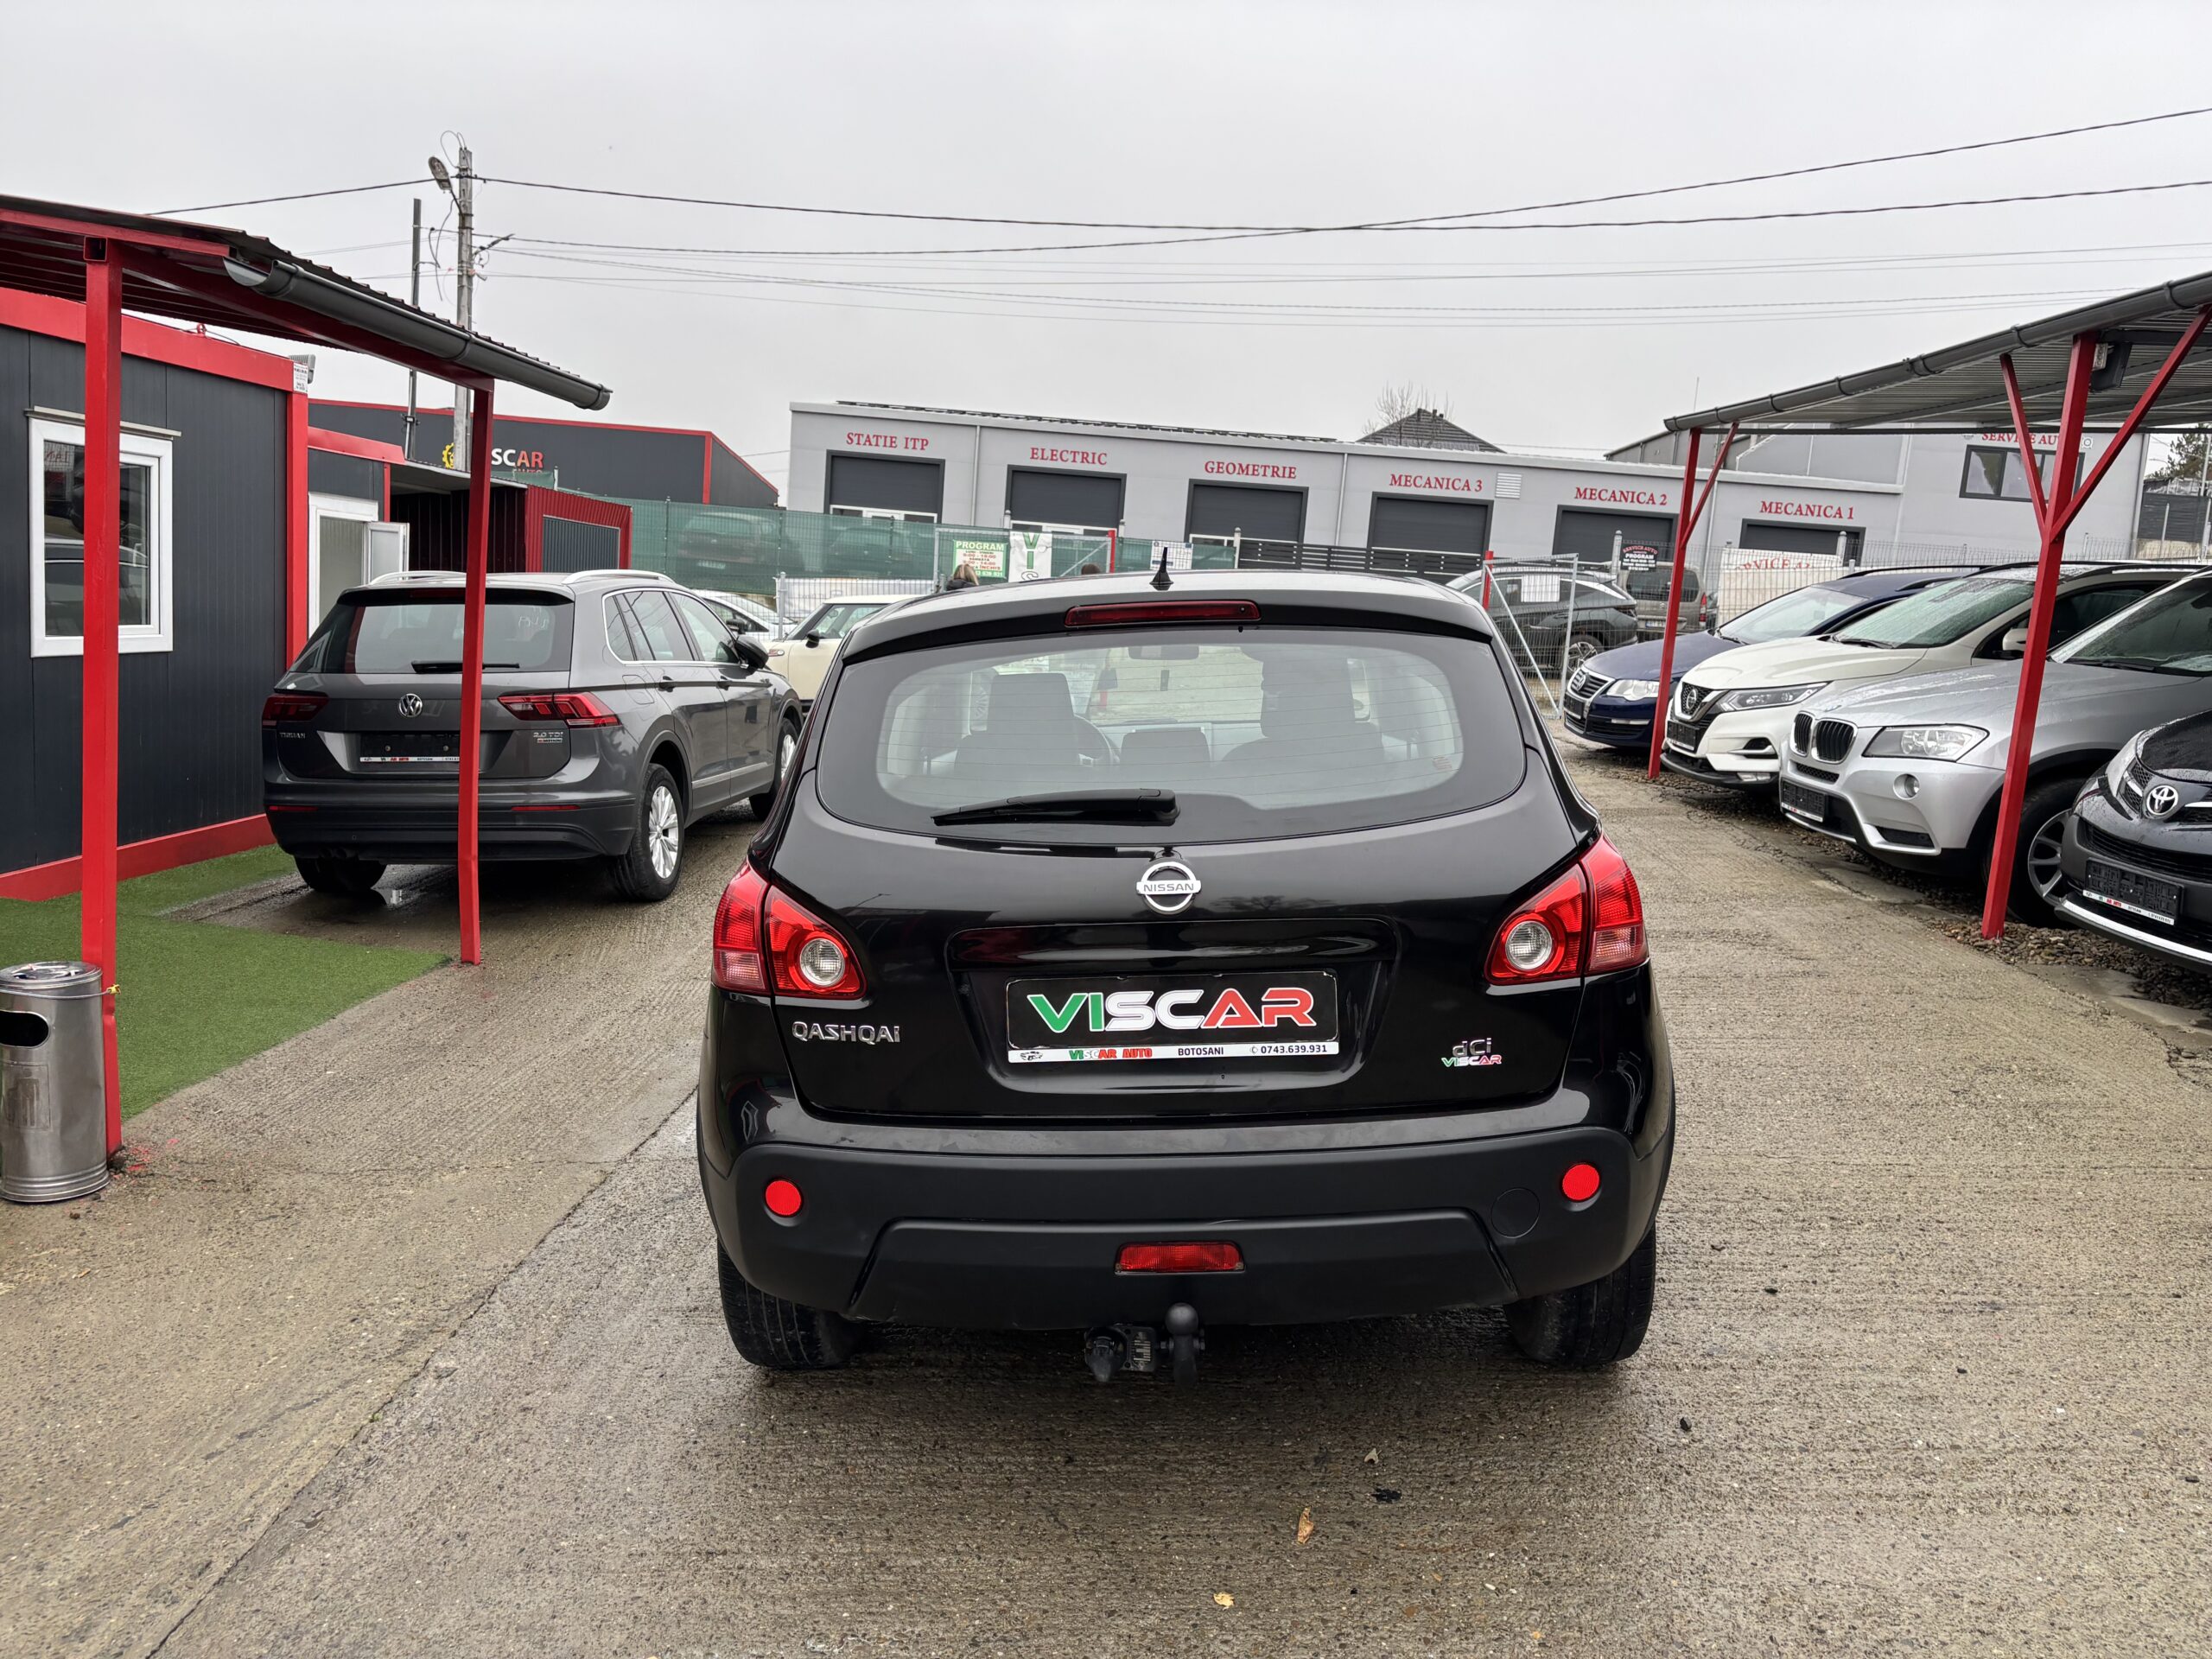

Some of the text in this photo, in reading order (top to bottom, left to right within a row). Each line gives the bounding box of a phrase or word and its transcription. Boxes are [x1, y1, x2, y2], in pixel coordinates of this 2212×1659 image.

[846, 432, 929, 450] STATIE ITP
[1981, 432, 2037, 444] SERVIE
[491, 448, 544, 468] SCAR
[1030, 447, 1107, 466] ELECTRIC
[1205, 461, 1297, 480] GEOMETRIE
[1389, 474, 1483, 493] MECANICA 3
[1574, 486, 1668, 505] MECANICA 2
[1760, 500, 1854, 519] MECANICA 1
[956, 541, 1004, 550] PROGRAM
[1143, 883, 1194, 892] NISSAN
[1027, 987, 1318, 1033] VISCAR
[791, 1021, 900, 1045] QASHQAI
[1069, 1045, 1328, 1060] VISCAR AUTO BOTOSANI 0743.639.931
[1441, 1054, 1502, 1067] VISCAR
